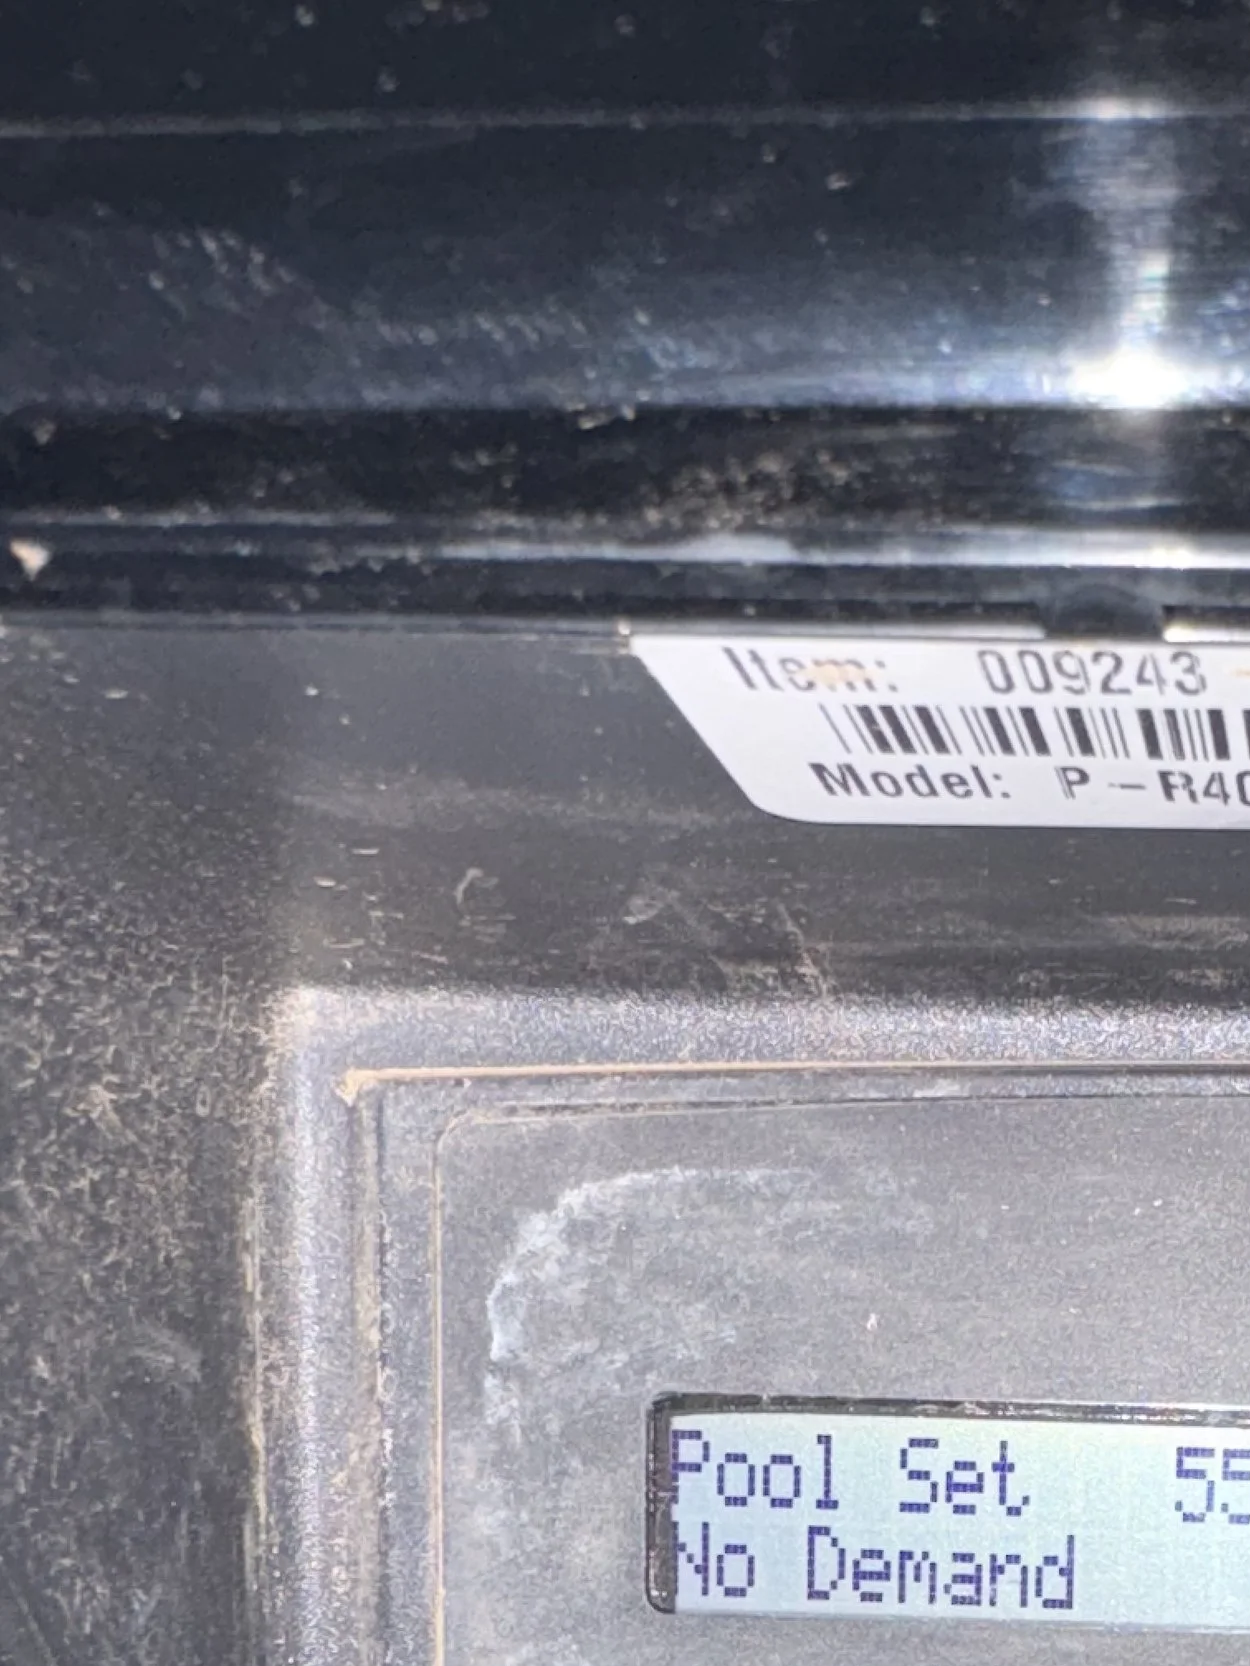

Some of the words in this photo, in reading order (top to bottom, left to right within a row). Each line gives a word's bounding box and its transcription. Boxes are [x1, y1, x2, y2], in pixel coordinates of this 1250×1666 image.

[721, 646, 899, 693] Item:
[976, 649, 1207, 696] 009243
[808, 762, 1011, 800] Model:
[671, 1429, 839, 1510] Pool
[899, 1438, 1030, 1517] Set
[671, 1520, 755, 1598] No
[807, 1525, 1075, 1609] Demand
